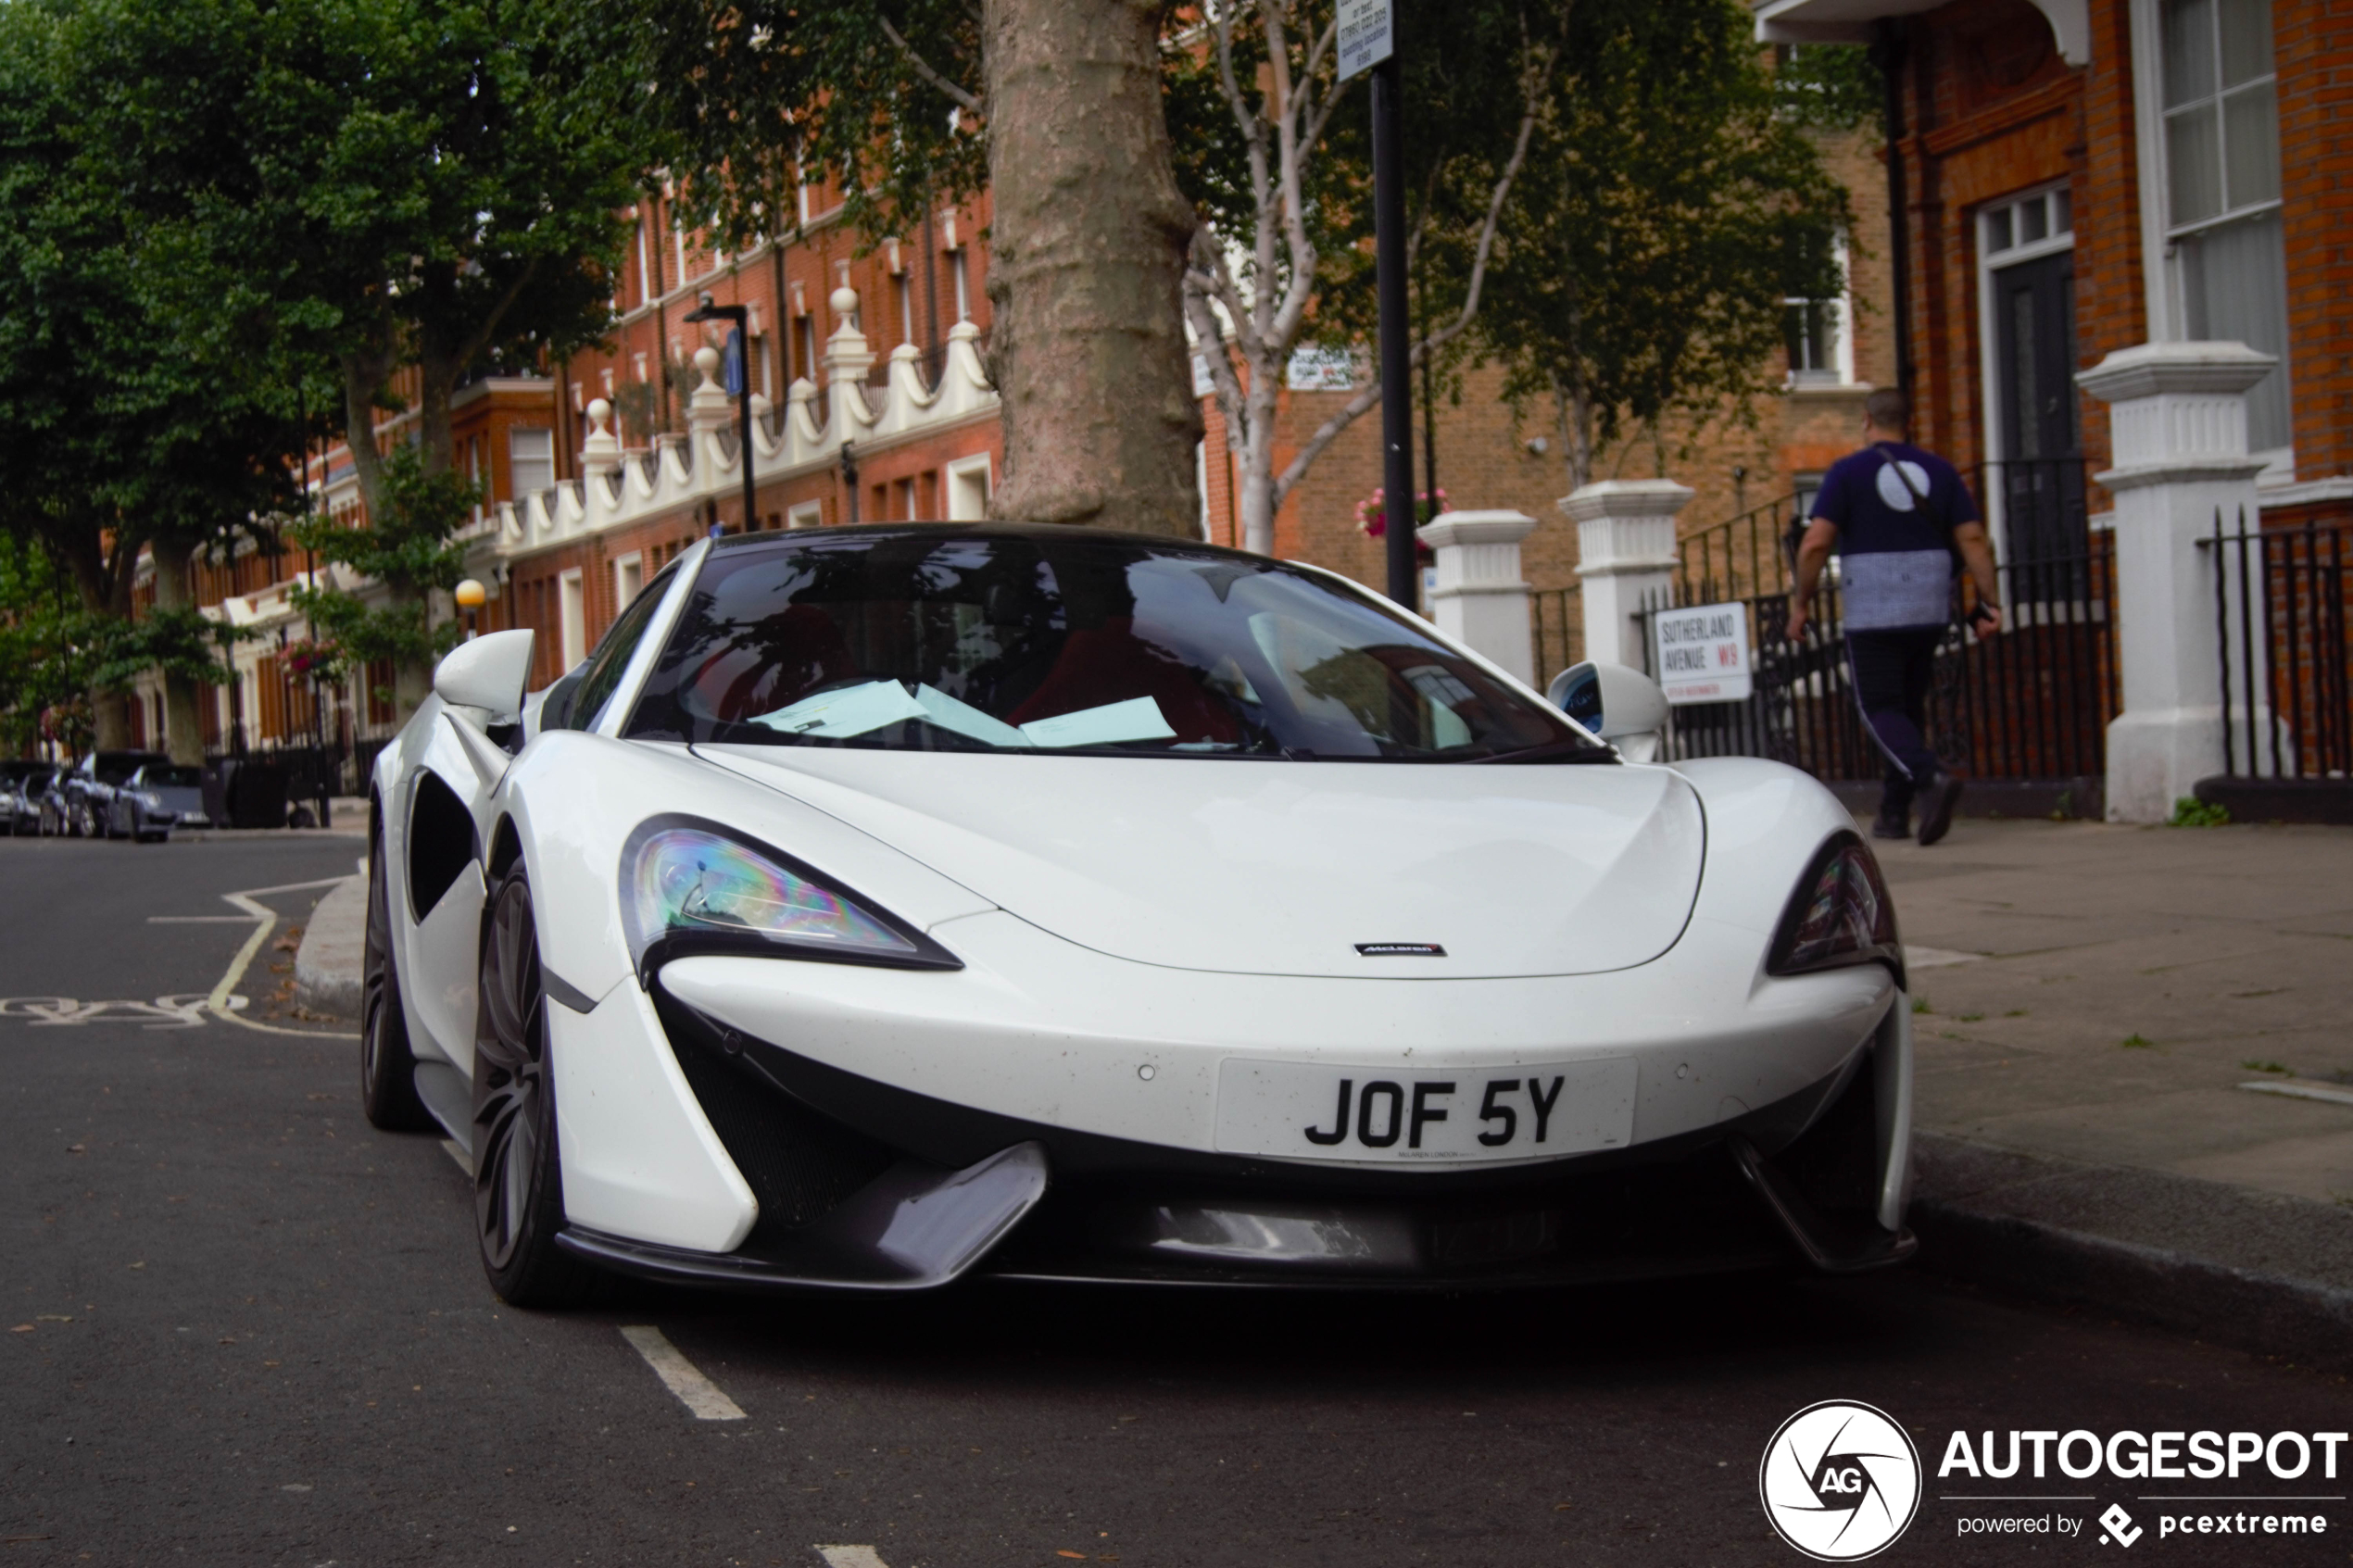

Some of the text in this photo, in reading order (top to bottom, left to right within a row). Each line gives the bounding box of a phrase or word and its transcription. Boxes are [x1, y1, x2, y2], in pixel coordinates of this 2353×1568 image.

[1361, 1, 1373, 15] text
[1342, 25, 1388, 58] quoting location
[1663, 613, 1734, 644] SUTHERLAND
[1666, 642, 1738, 671] AVENUE W9
[1304, 1075, 1566, 1148] JOF 5Y
